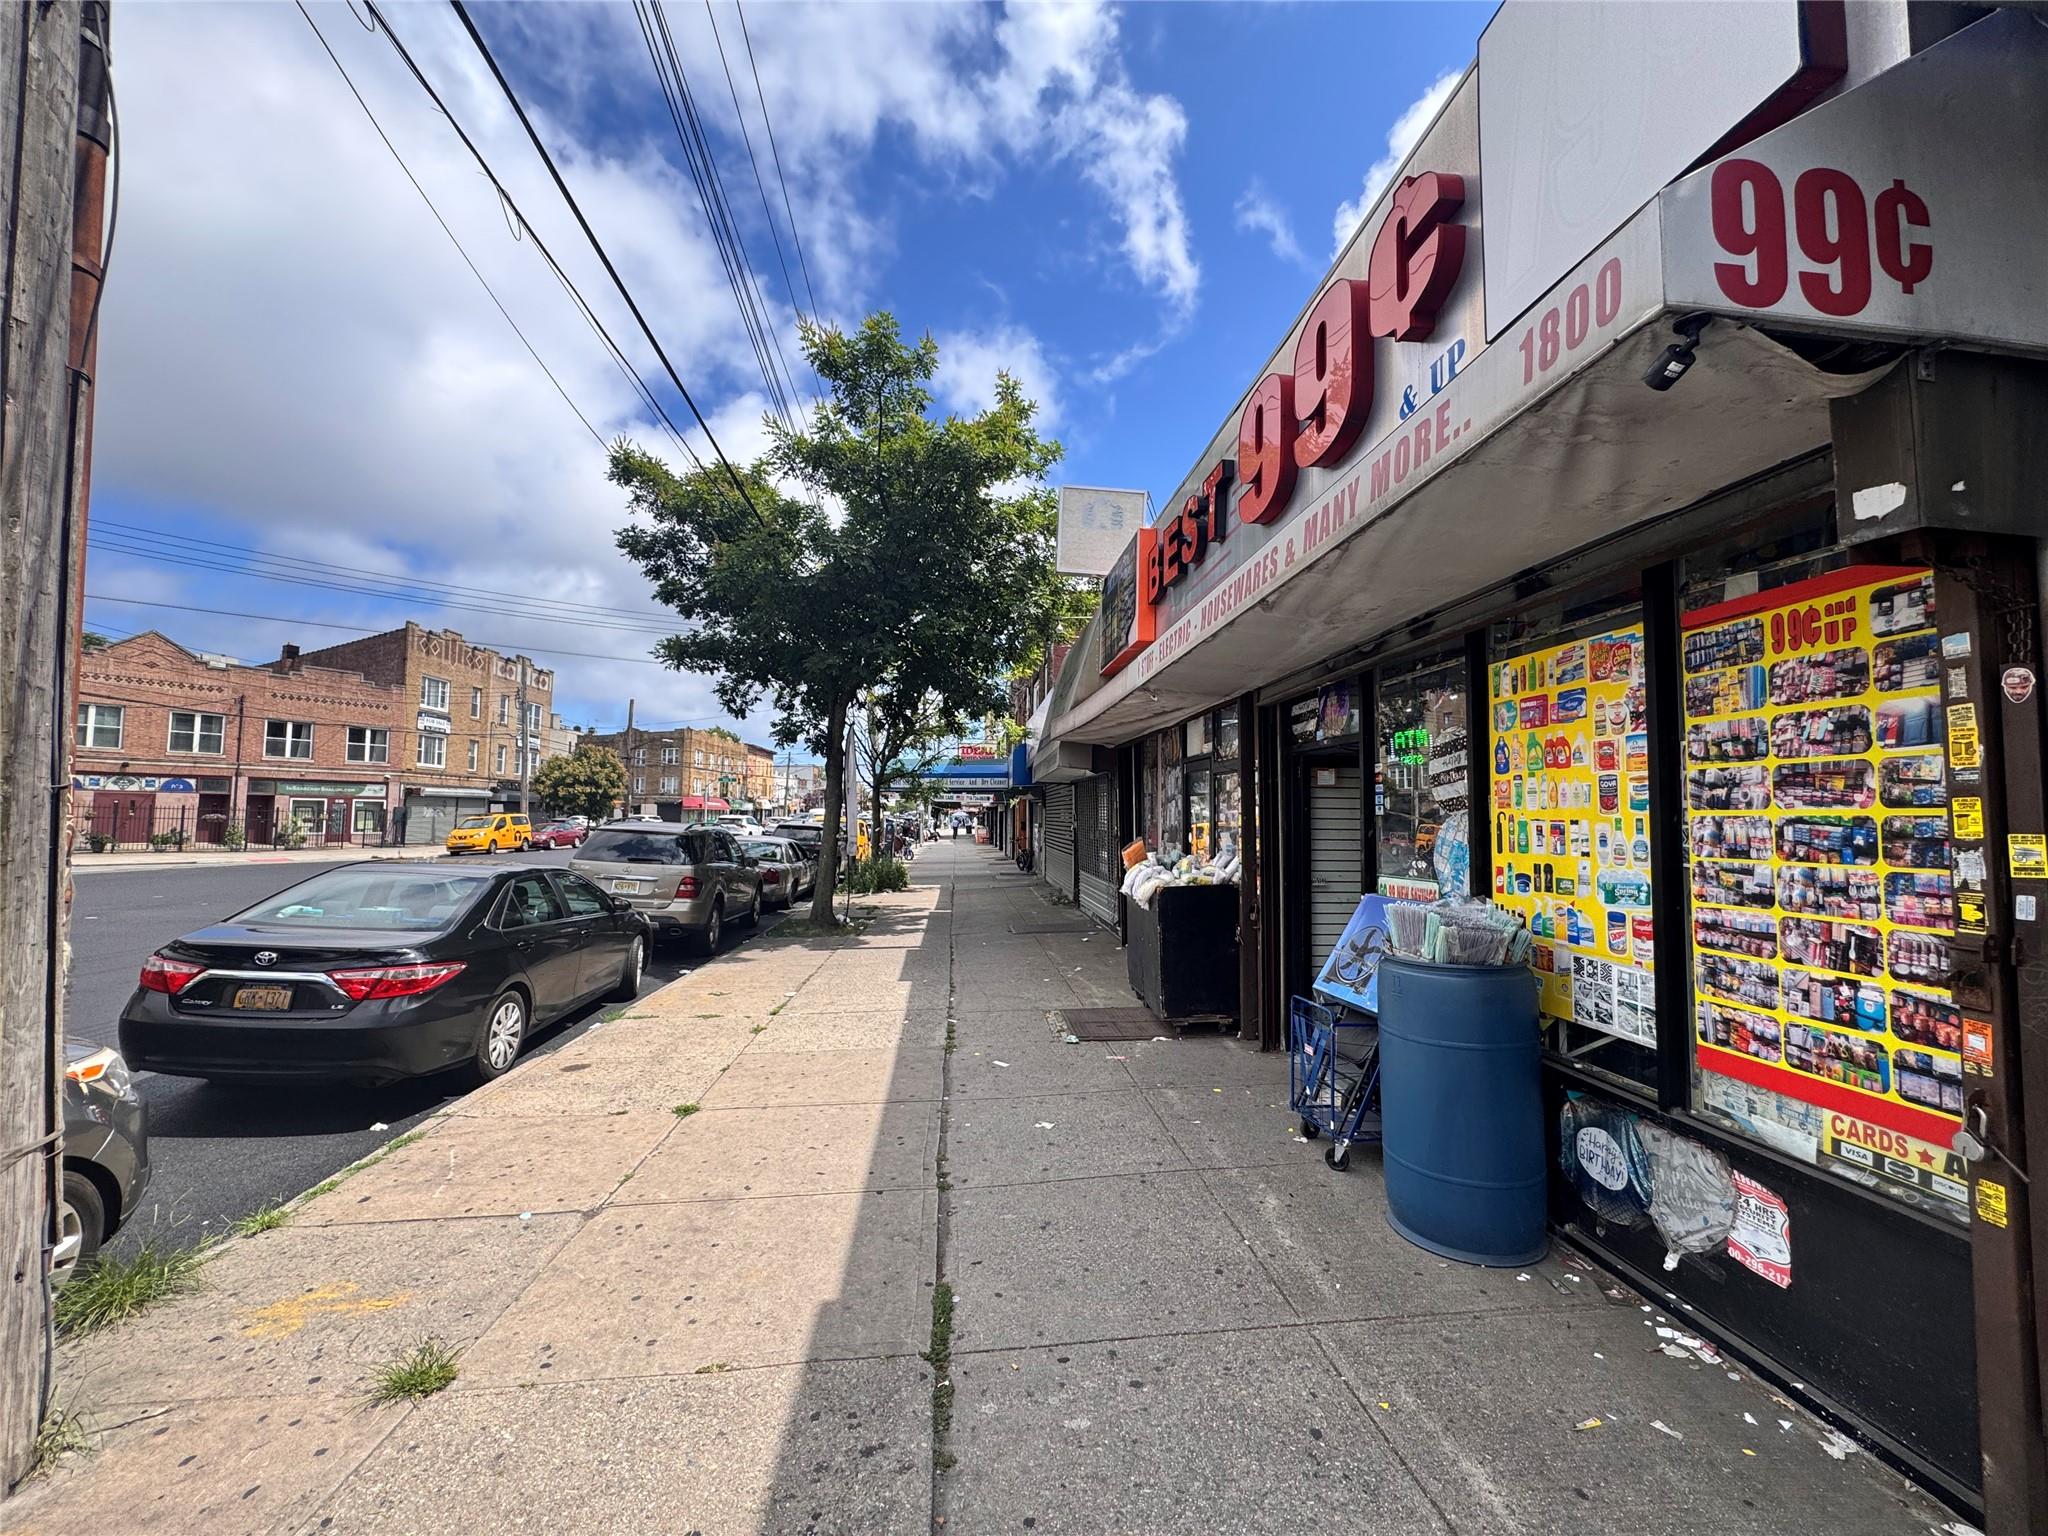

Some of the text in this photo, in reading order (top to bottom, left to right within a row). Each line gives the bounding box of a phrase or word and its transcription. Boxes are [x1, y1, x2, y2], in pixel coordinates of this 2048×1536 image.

[1711, 158, 1933, 317] 99¢
[1149, 171, 1466, 606] BEST 99¢
[1399, 338, 1465, 420] & UP
[1158, 618, 1191, 662] ELECTRIC
[1200, 545, 1279, 633] HOUSEWARES
[1284, 537, 1296, 568] &
[1303, 475, 1360, 554] MANY
[1370, 398, 1472, 504] MORE..
[1518, 256, 1622, 386] 1800
[1770, 595, 1856, 655] 99¢ and
[1824, 617, 1857, 645] UP
[1393, 728, 1429, 750] ATM
[1579, 1145, 1624, 1182] BIRTHDAY!
[1588, 1132, 1618, 1164] Happy
[1830, 1114, 1909, 1159] CARDS
[1943, 1151, 1968, 1179] A
[1843, 1146, 1868, 1161] VISA
[1739, 1203, 1777, 1226] ECURITY
[1741, 1209, 1777, 1230] YSTEMS
[1754, 1202, 1776, 1220] HRS
